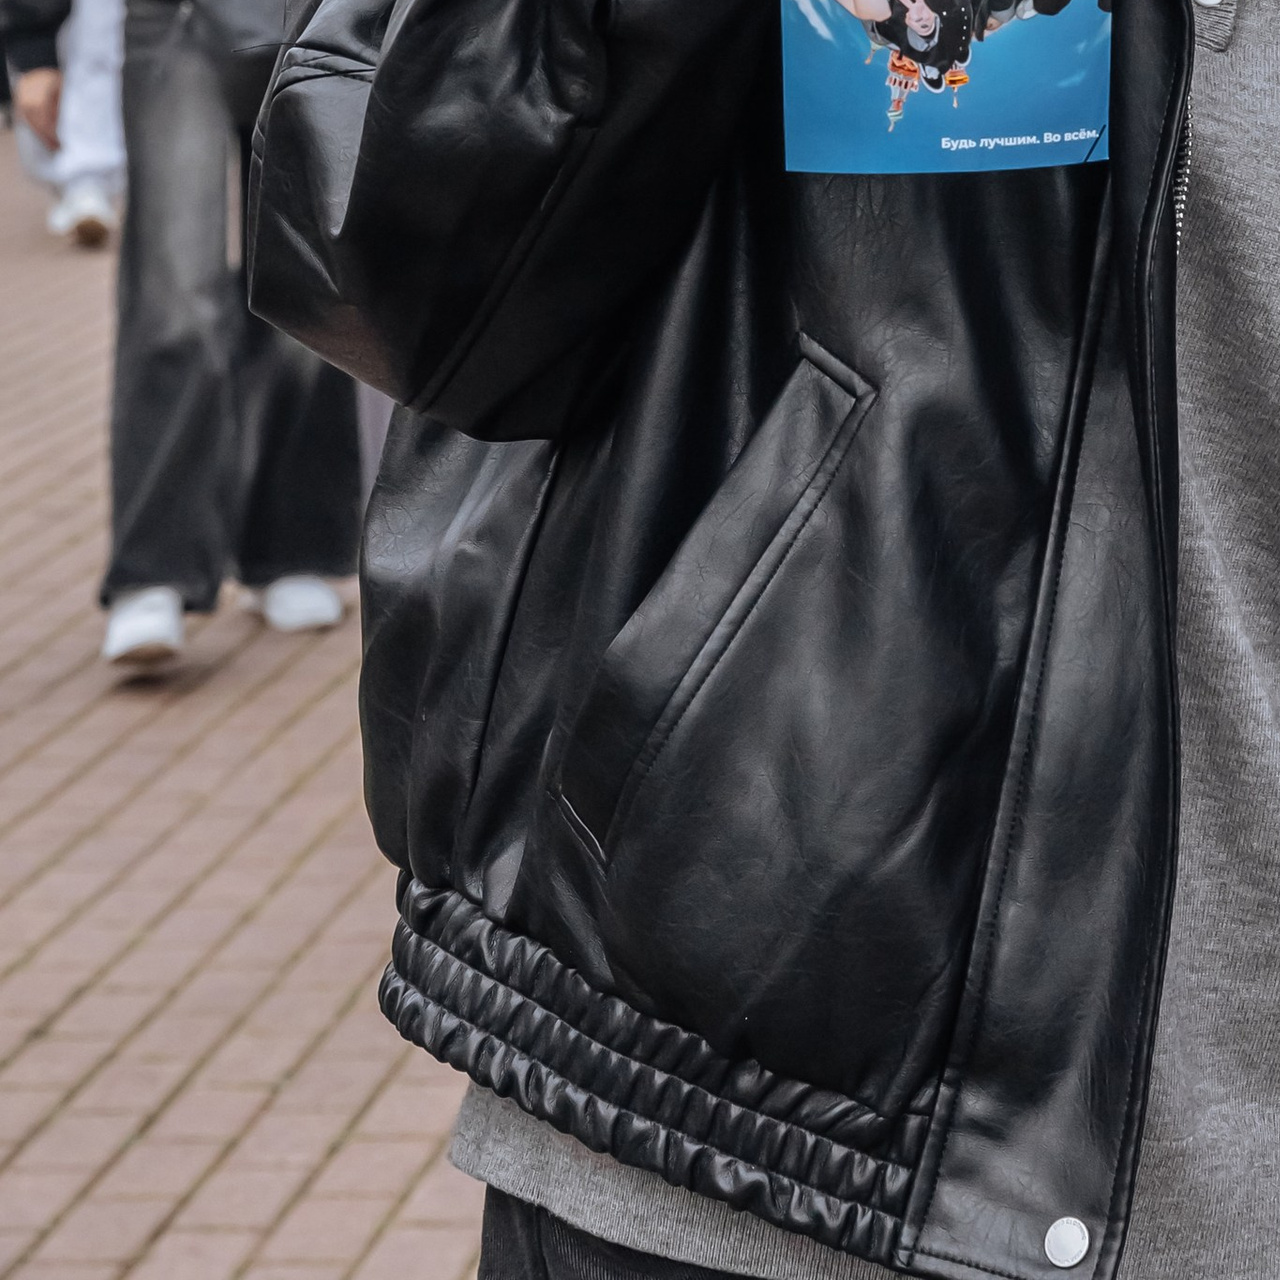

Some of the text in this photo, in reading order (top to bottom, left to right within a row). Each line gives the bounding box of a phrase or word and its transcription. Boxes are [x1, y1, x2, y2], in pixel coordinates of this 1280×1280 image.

[941, 128, 1100, 151] Будь лучшим. Во всём.
